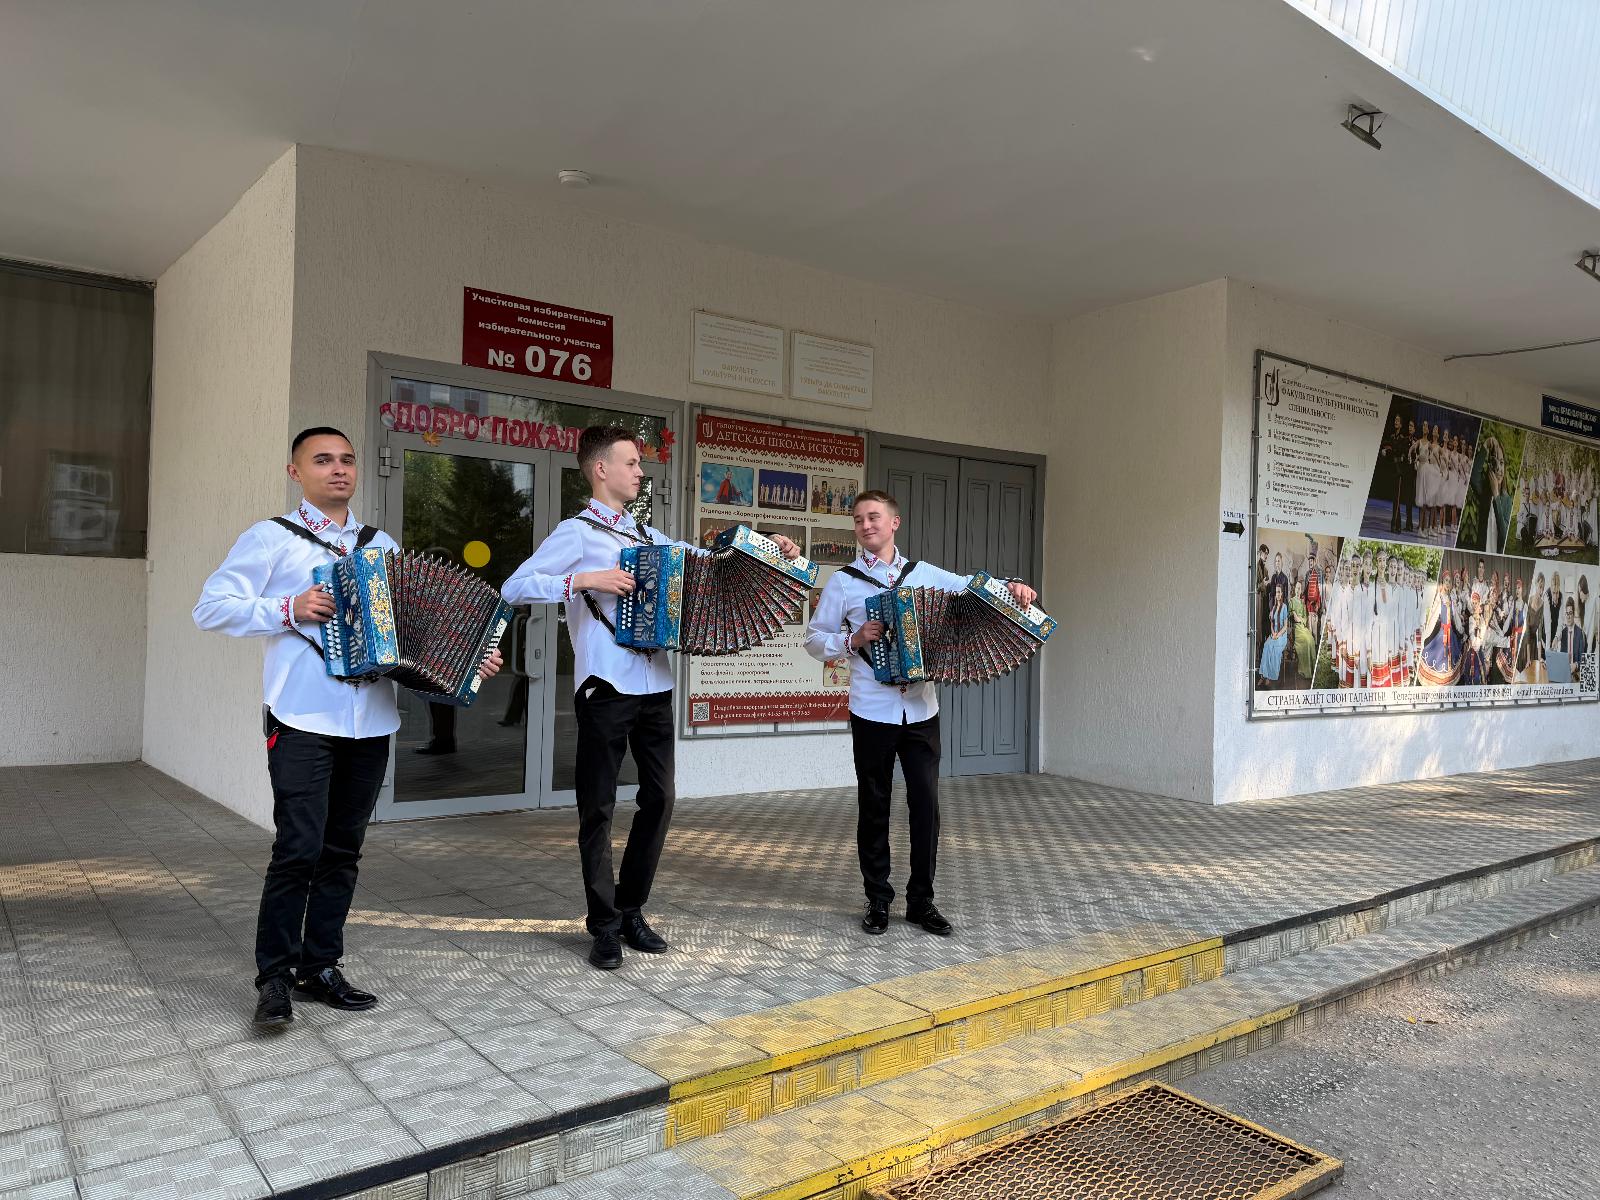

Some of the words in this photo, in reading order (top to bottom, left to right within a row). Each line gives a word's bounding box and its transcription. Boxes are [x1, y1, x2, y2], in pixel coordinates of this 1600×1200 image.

[472, 292, 531, 312] Участковая
[533, 305, 607, 327] избирательная
[517, 315, 566, 331] комиссия
[478, 321, 561, 342] избирательного
[563, 337, 601, 350] участка
[487, 348, 515, 368] №
[525, 345, 592, 381] 076
[1281, 387, 1315, 403] ФАКУЛЬТЕТ
[394, 402, 480, 441] ДОБРО
[716, 430, 766, 446] ДЕТСКАЯ
[768, 437, 806, 451] ШКОЛА
[808, 442, 860, 458] ИСКУССТВ
[1267, 695, 1300, 706] СТРАНА
[1301, 692, 1325, 706] ЖДЁТ
[1326, 693, 1347, 704] СВОИ
